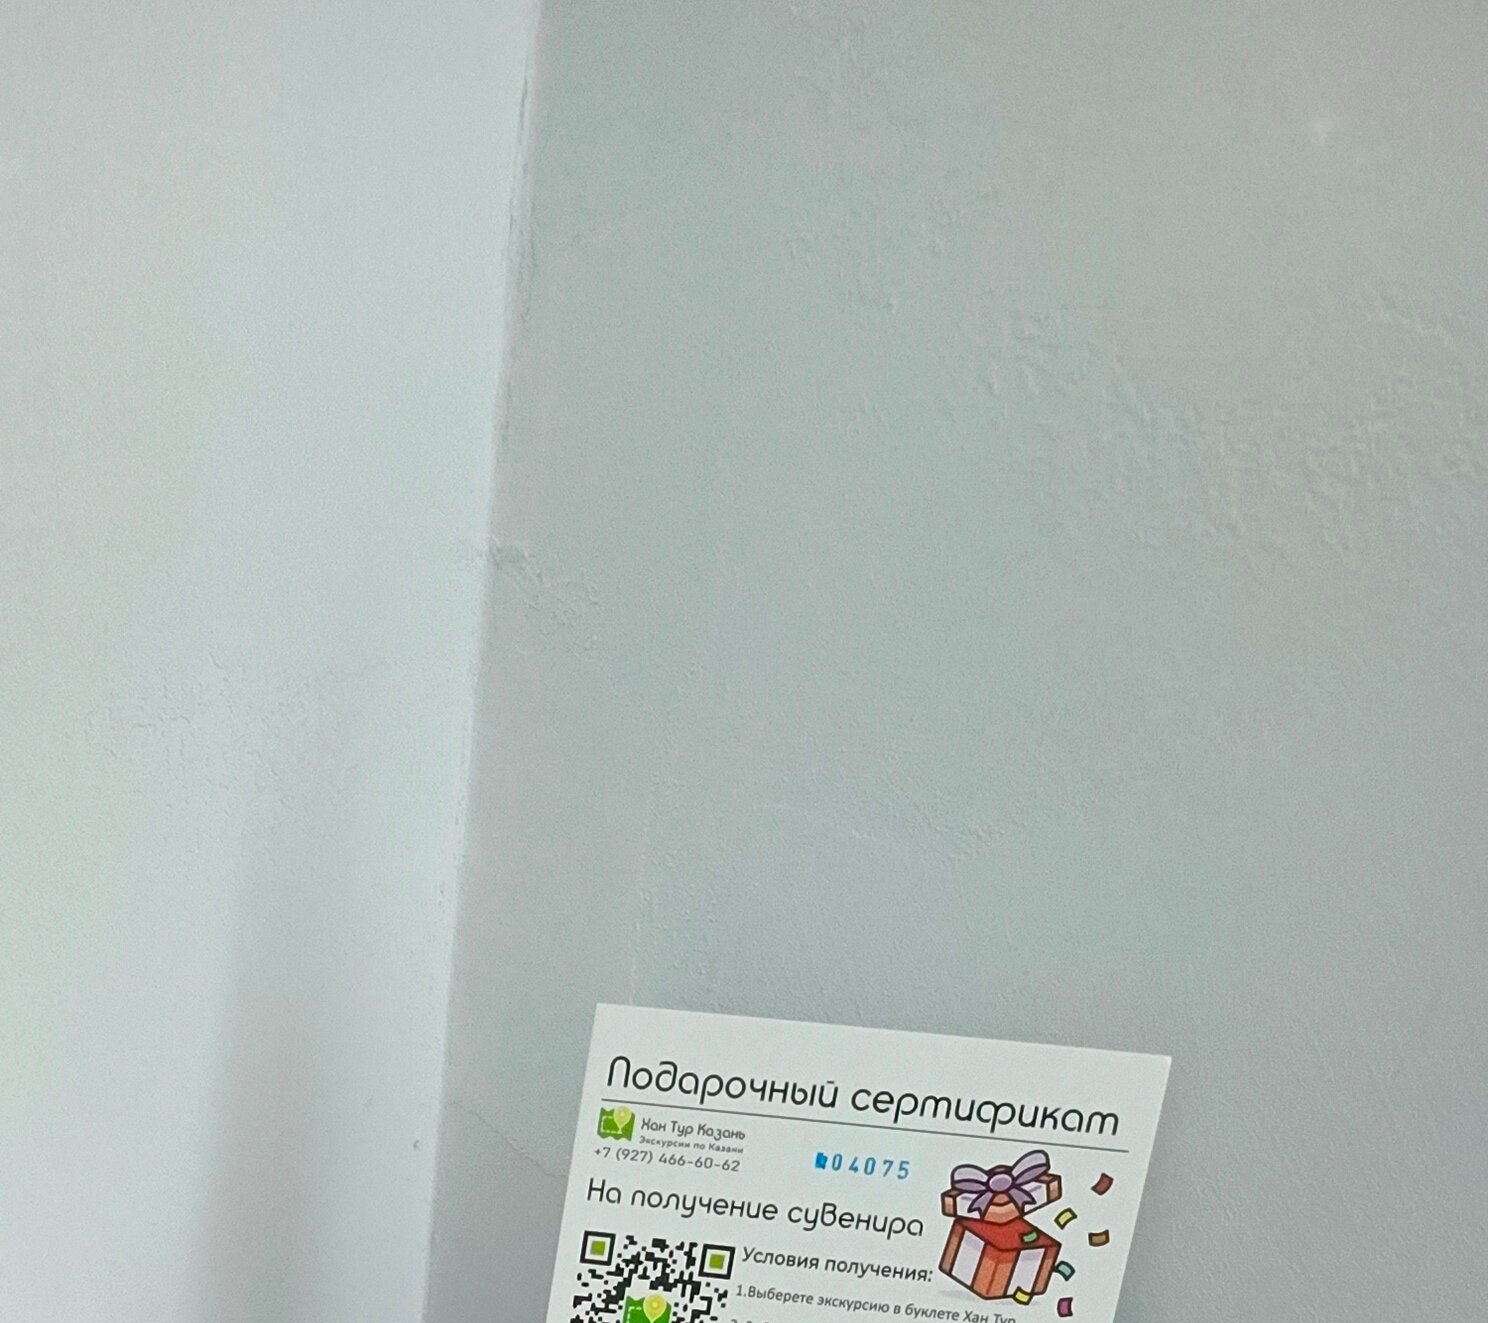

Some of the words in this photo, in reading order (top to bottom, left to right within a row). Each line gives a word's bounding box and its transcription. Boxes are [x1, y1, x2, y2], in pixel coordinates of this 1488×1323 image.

[606, 1055, 839, 1108] Подарочный
[850, 1088, 1119, 1136] сертификат
[640, 1117, 666, 1131] Хан
[670, 1120, 694, 1137] Тур
[696, 1123, 745, 1141] Казань
[593, 1146, 611, 1158] +7
[615, 1147, 653, 1164] (927)
[658, 1152, 740, 1172] 466-60-62
[586, 1177, 621, 1204] На
[630, 1189, 778, 1220] получение
[787, 1201, 923, 1240] сувенира
[741, 1245, 819, 1269] Условия
[824, 1258, 933, 1282] получения:
[735, 1284, 813, 1304] 1.Выберете
[816, 1295, 890, 1313] экскурсию
[892, 1304, 901, 1314] в
[904, 1302, 960, 1321] буклете
[962, 1309, 989, 1323] Хан
